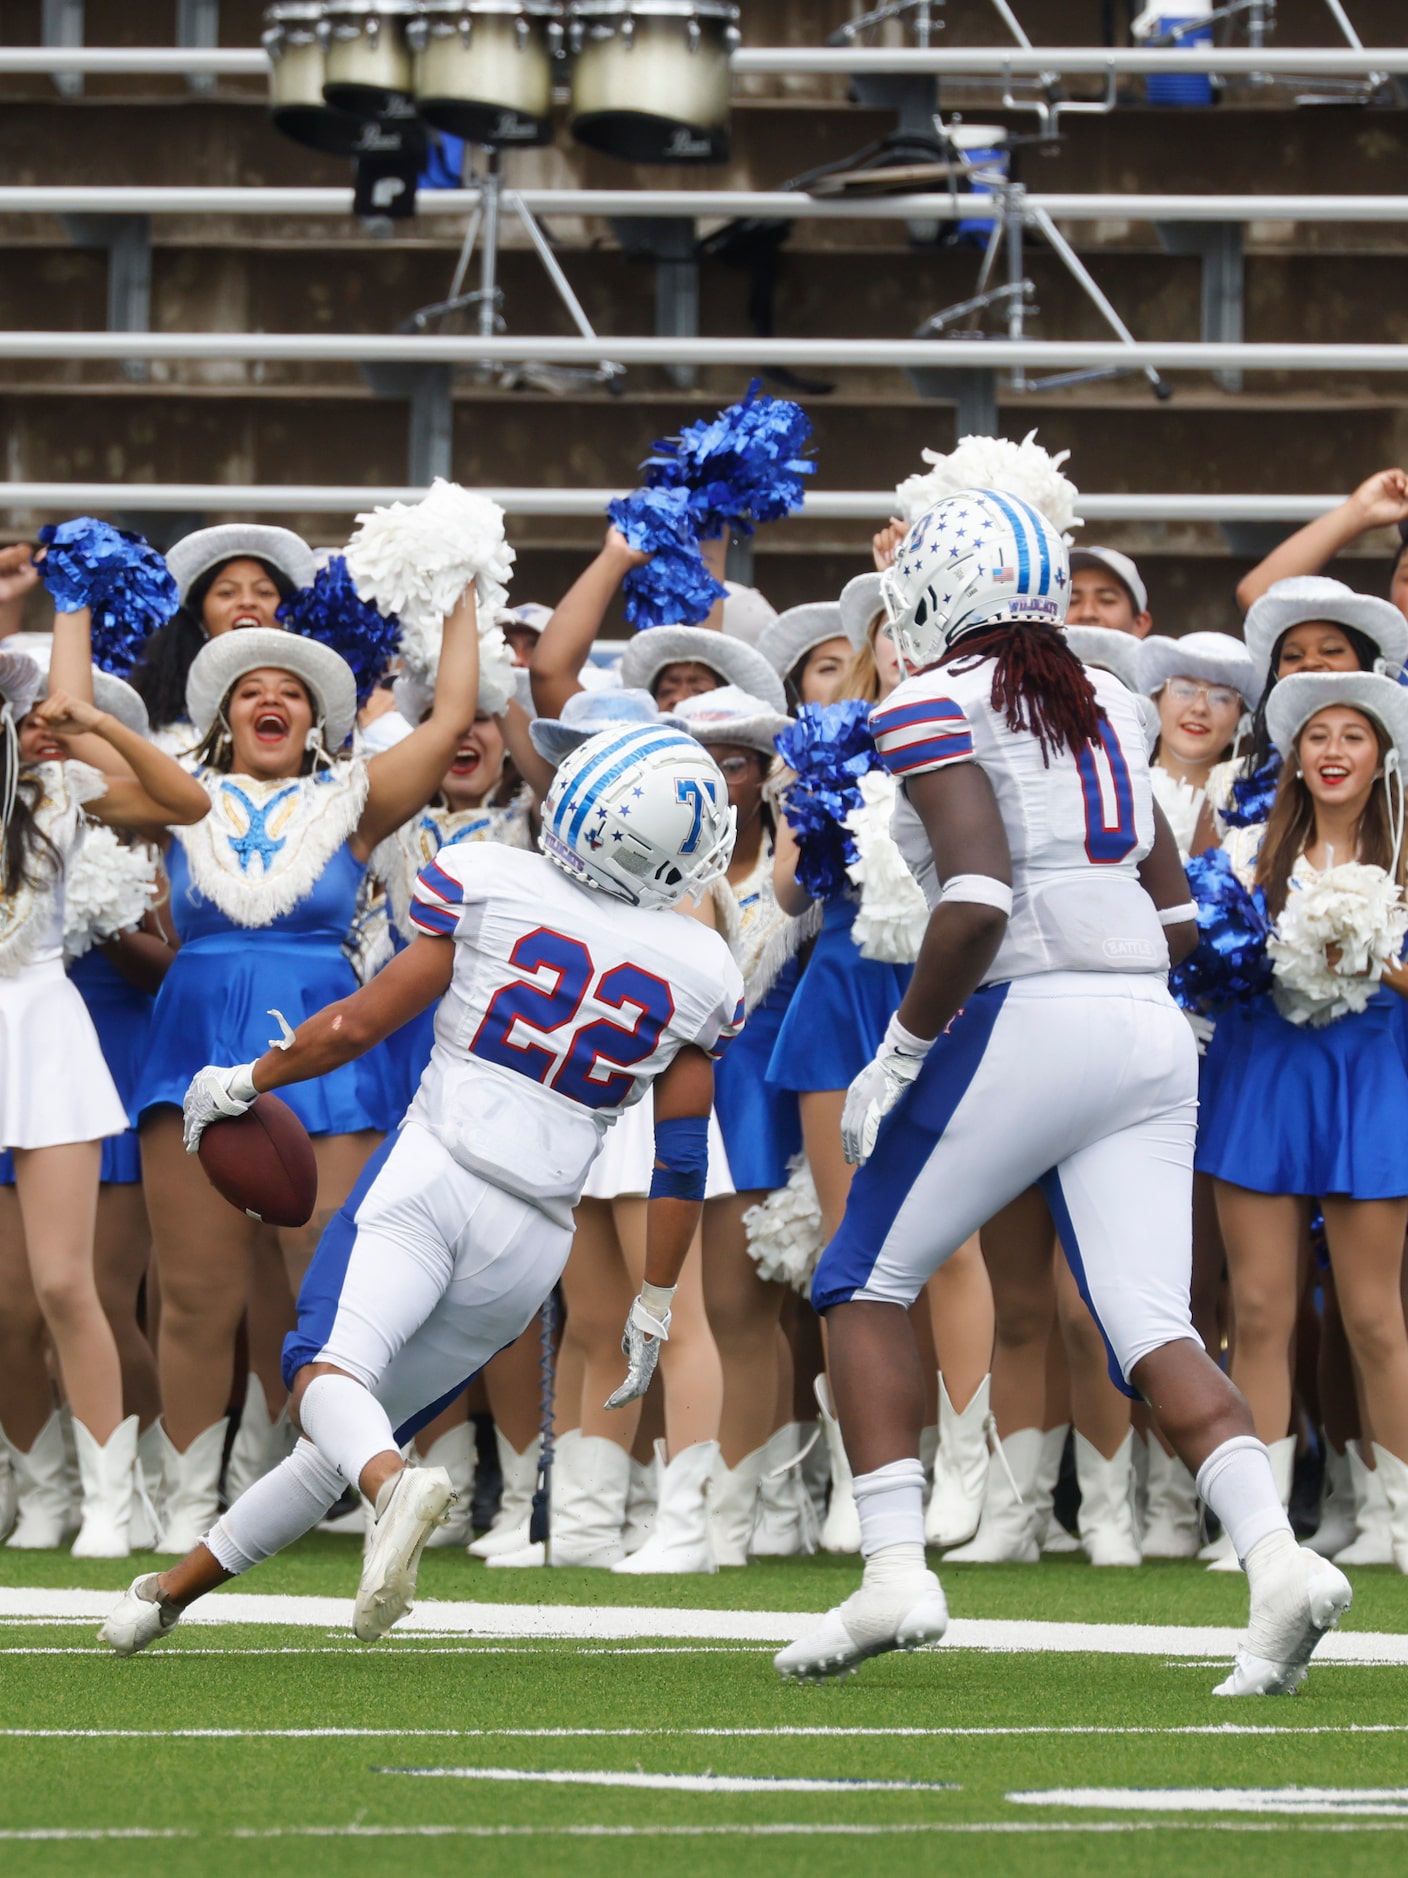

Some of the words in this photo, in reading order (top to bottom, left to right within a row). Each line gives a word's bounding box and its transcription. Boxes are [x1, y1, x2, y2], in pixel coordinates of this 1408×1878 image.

[1008, 598, 1059, 617] WILDCATS
[673, 776, 718, 857] T
[545, 831, 586, 873] WILDCATS
[1107, 940, 1153, 957] BATTLE
[468, 926, 676, 1110] 22
